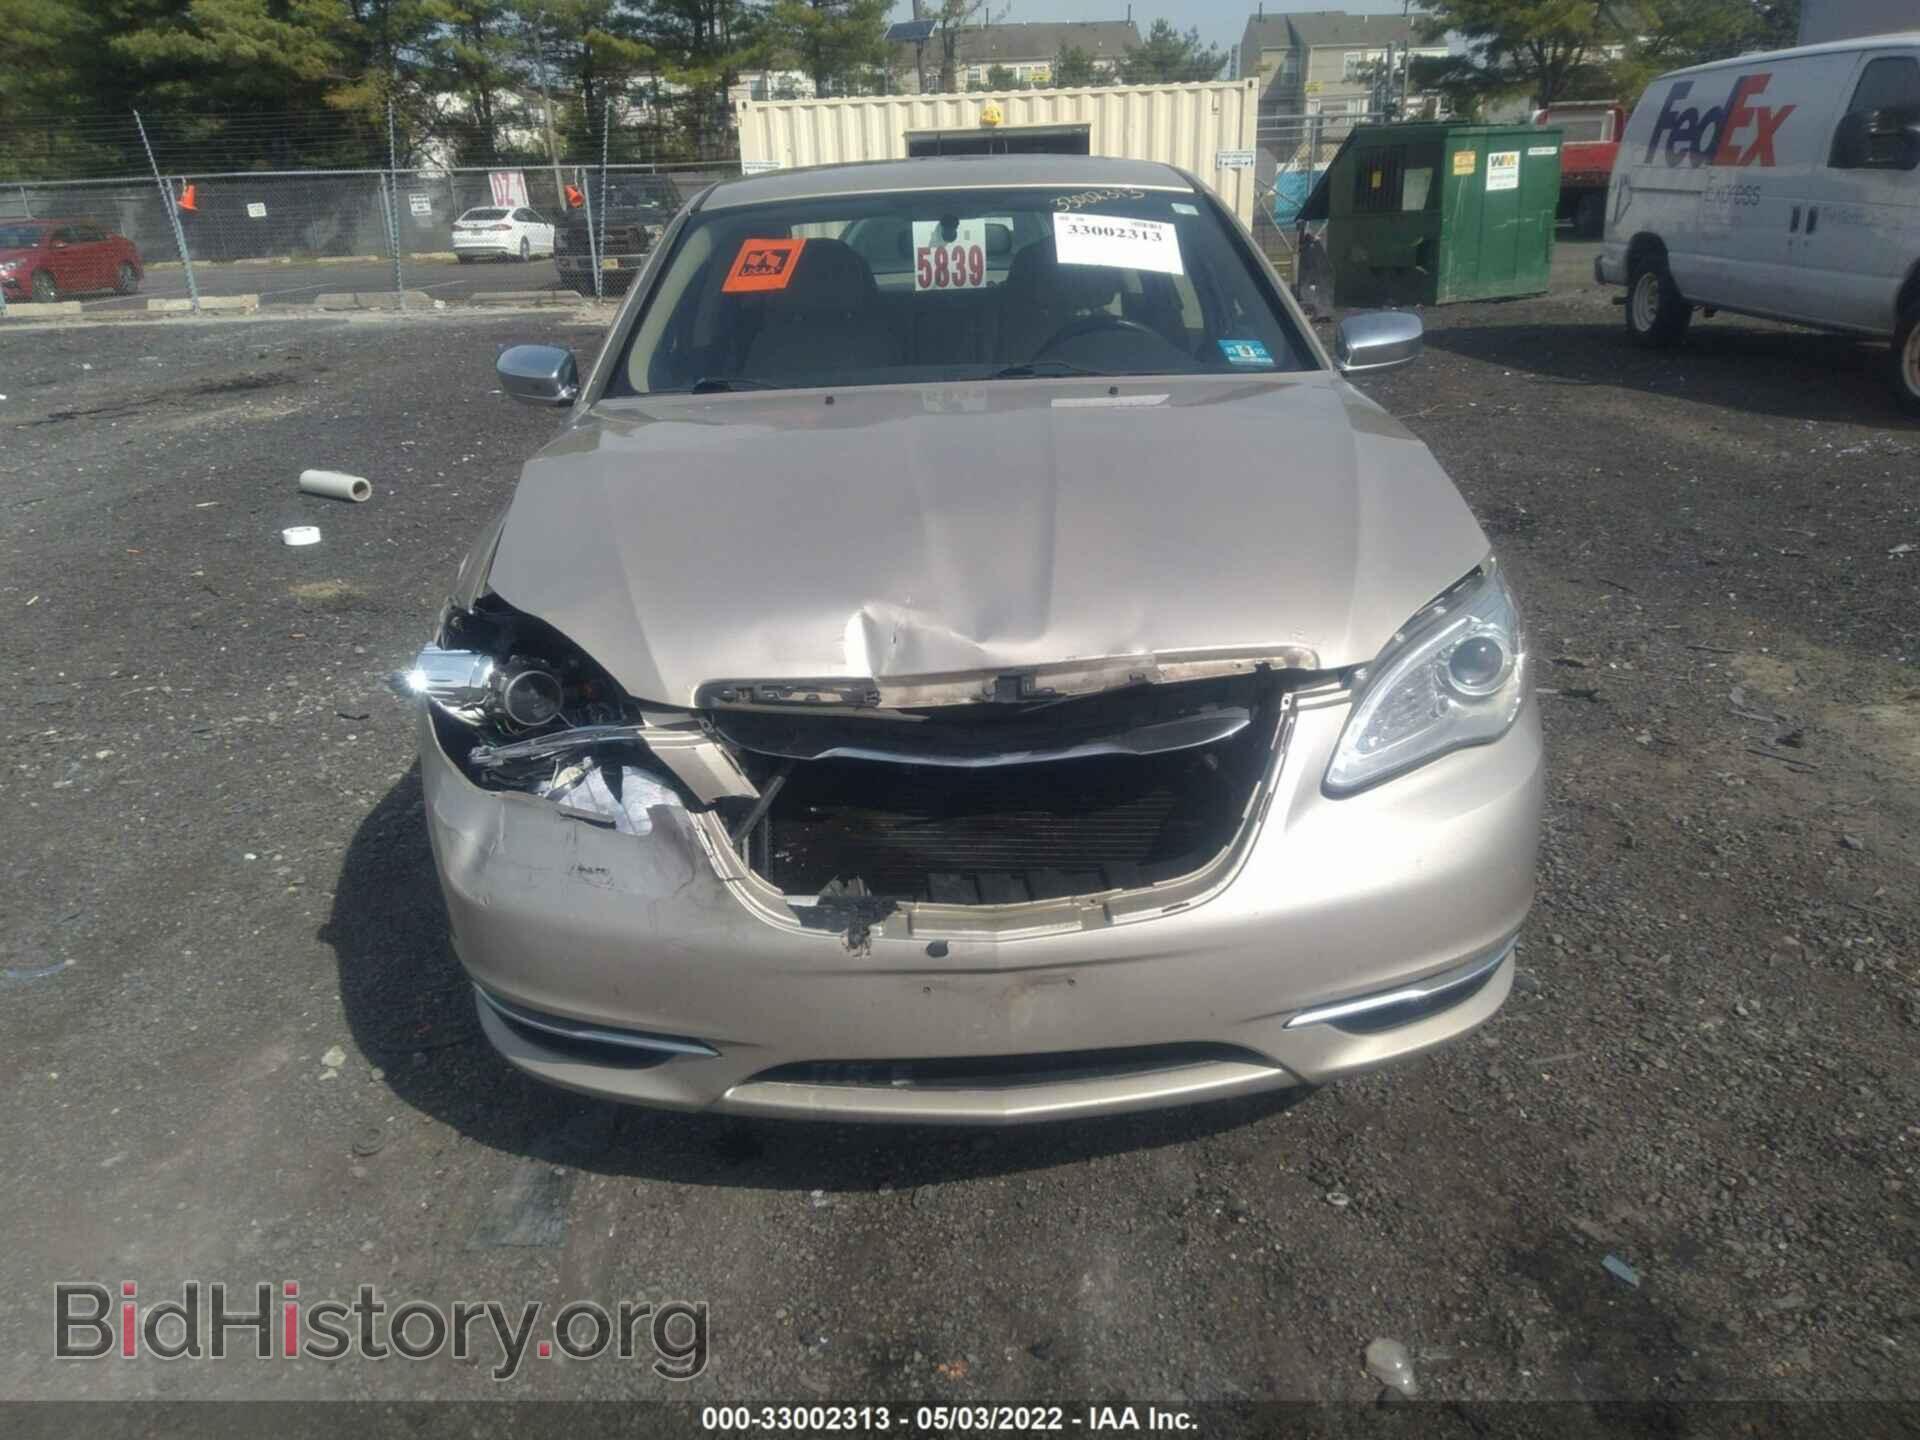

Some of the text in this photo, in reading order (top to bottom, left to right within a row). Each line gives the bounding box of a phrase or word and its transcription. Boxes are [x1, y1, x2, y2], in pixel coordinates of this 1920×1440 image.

[1644, 73, 1797, 168] FedEx
[1066, 224, 1163, 242] 33002313
[917, 244, 984, 288] 5839
